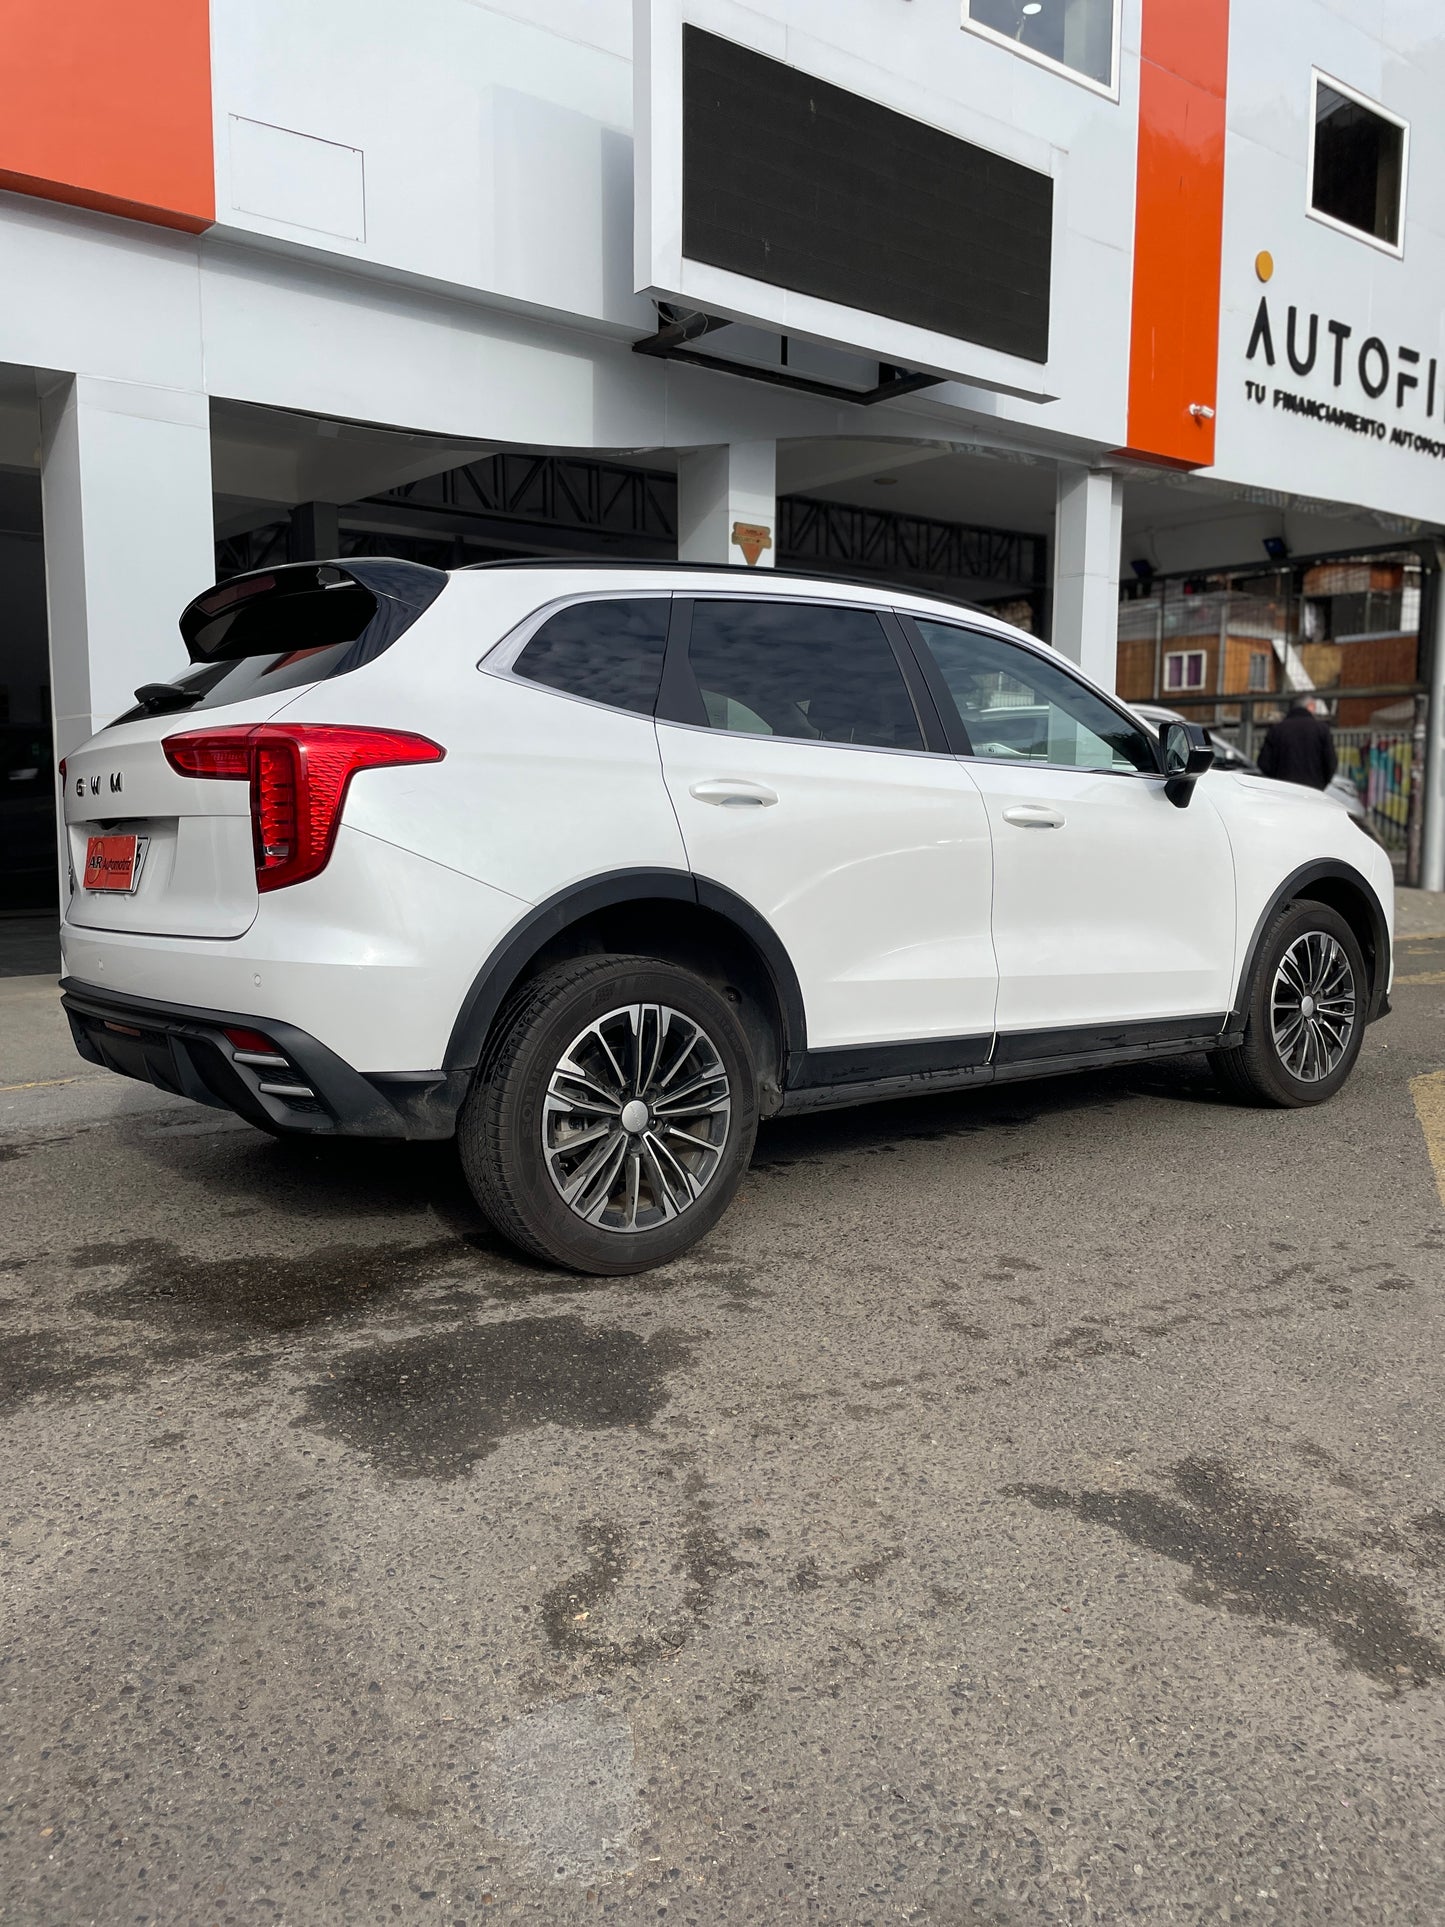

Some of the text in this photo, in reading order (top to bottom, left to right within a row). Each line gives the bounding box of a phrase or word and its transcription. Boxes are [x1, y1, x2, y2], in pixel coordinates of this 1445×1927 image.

[1246, 296, 1445, 424] AUTOFI
[1245, 380, 1266, 404] TU
[1273, 389, 1386, 440] FINANCIAMIENTO
